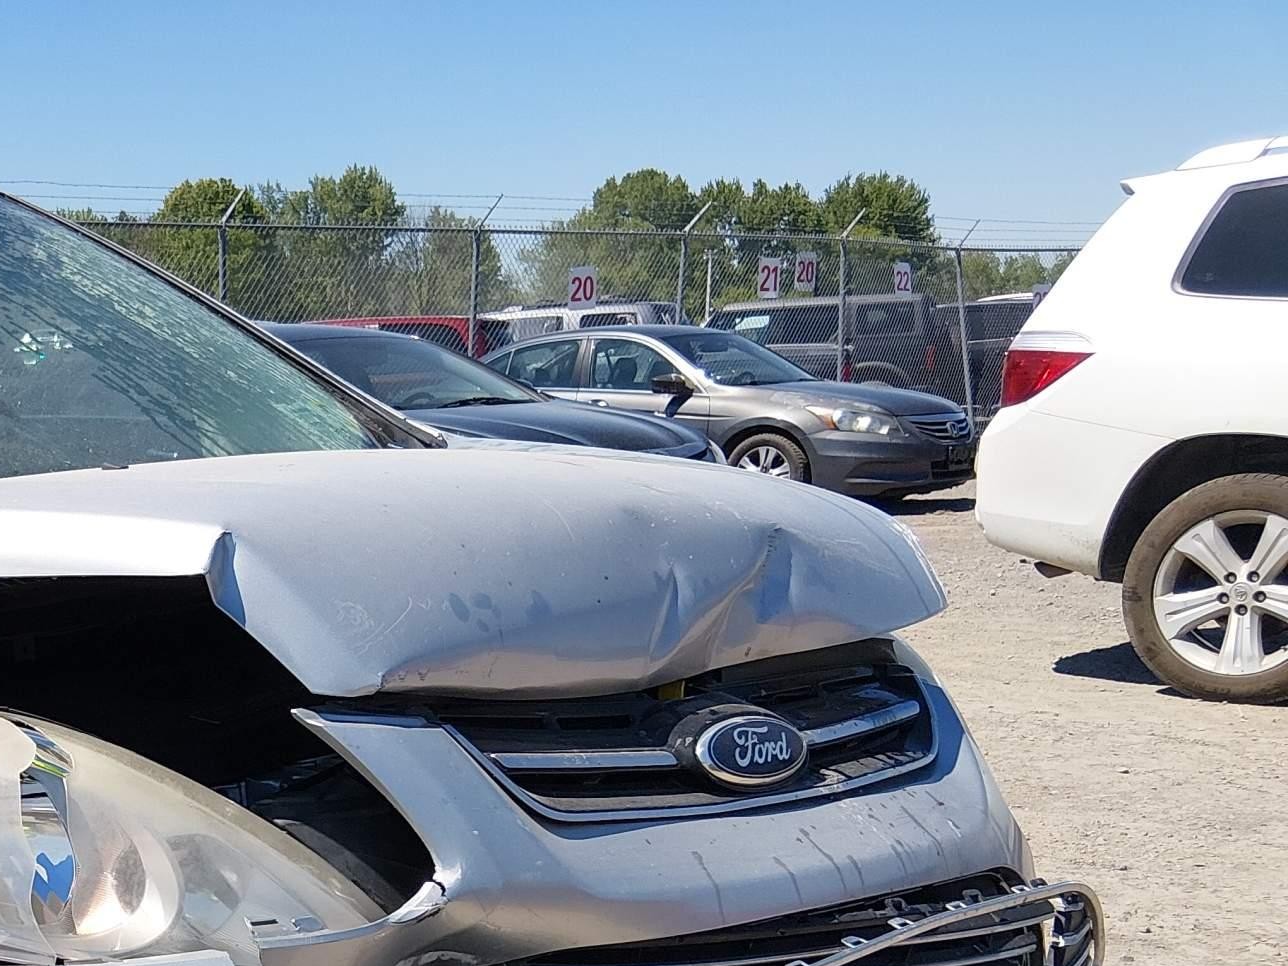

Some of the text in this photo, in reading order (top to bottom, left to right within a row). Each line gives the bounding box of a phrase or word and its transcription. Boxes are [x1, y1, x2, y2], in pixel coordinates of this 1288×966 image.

[760, 265, 779, 292] 21
[797, 261, 814, 283] 20
[897, 271, 910, 291] 22
[571, 276, 594, 301] 20
[1034, 291, 1048, 309] 2
[733, 726, 791, 767] Ford
